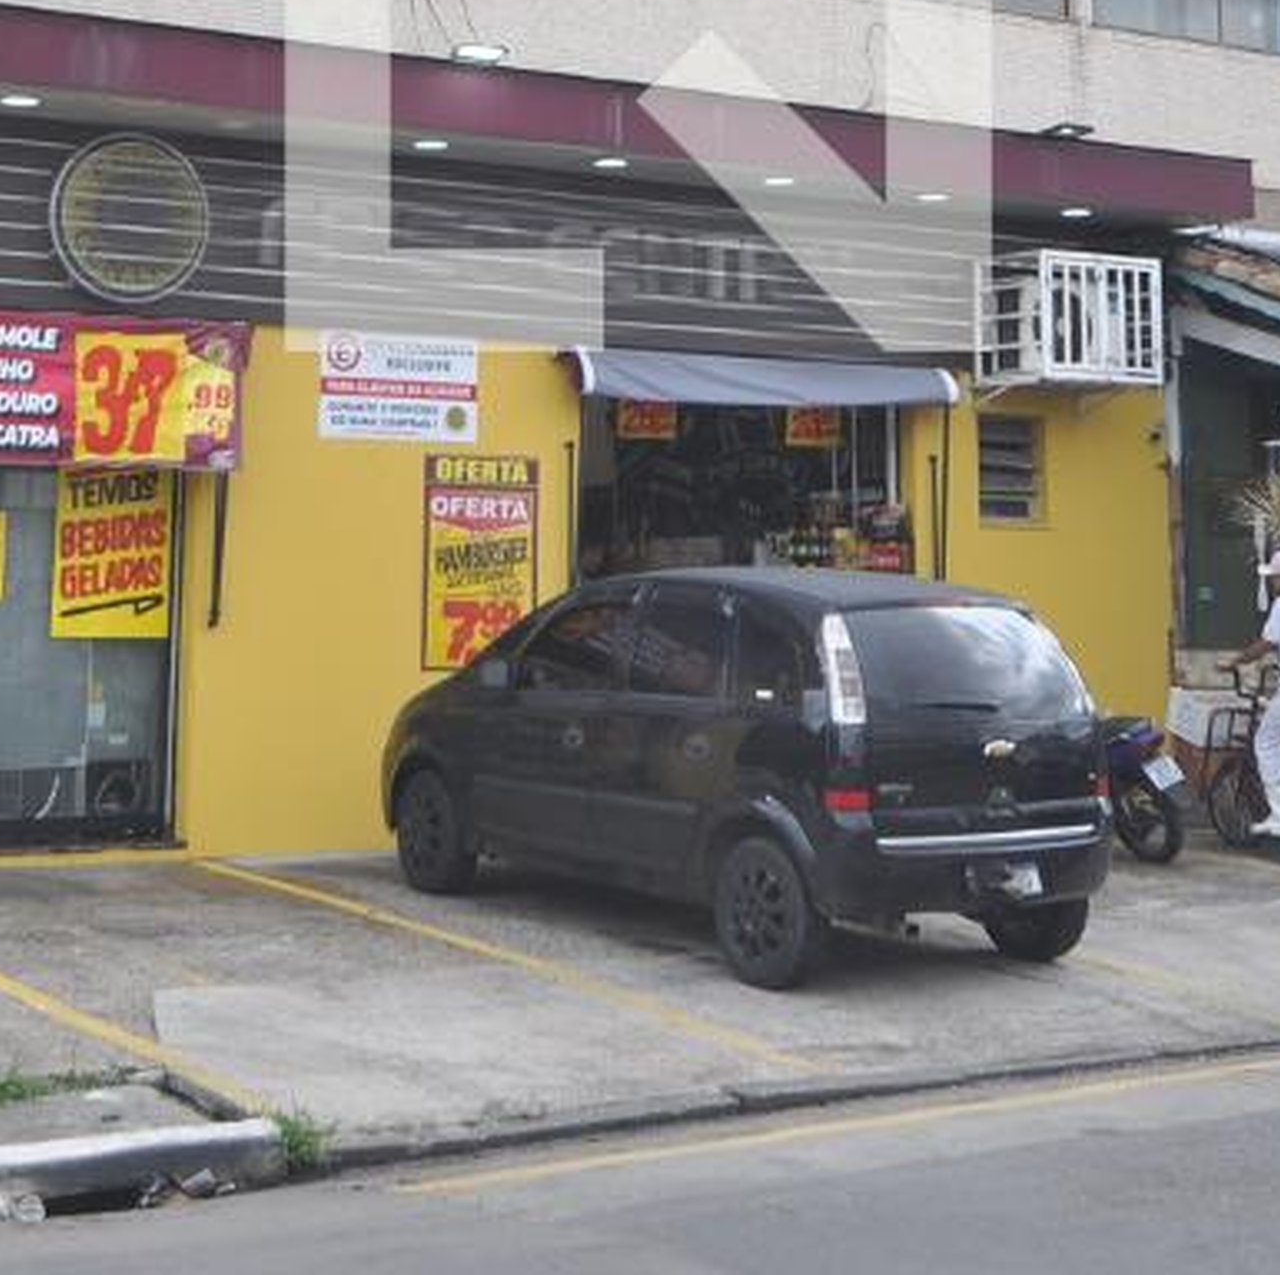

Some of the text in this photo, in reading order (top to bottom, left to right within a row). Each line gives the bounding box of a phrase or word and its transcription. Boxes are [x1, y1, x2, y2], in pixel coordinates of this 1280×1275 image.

[81, 345, 178, 455] 37
[70, 471, 158, 509] TEMOS
[431, 496, 528, 521] OFERTA
[60, 508, 167, 559] BEBIDAS
[60, 555, 163, 600] GELADAS
